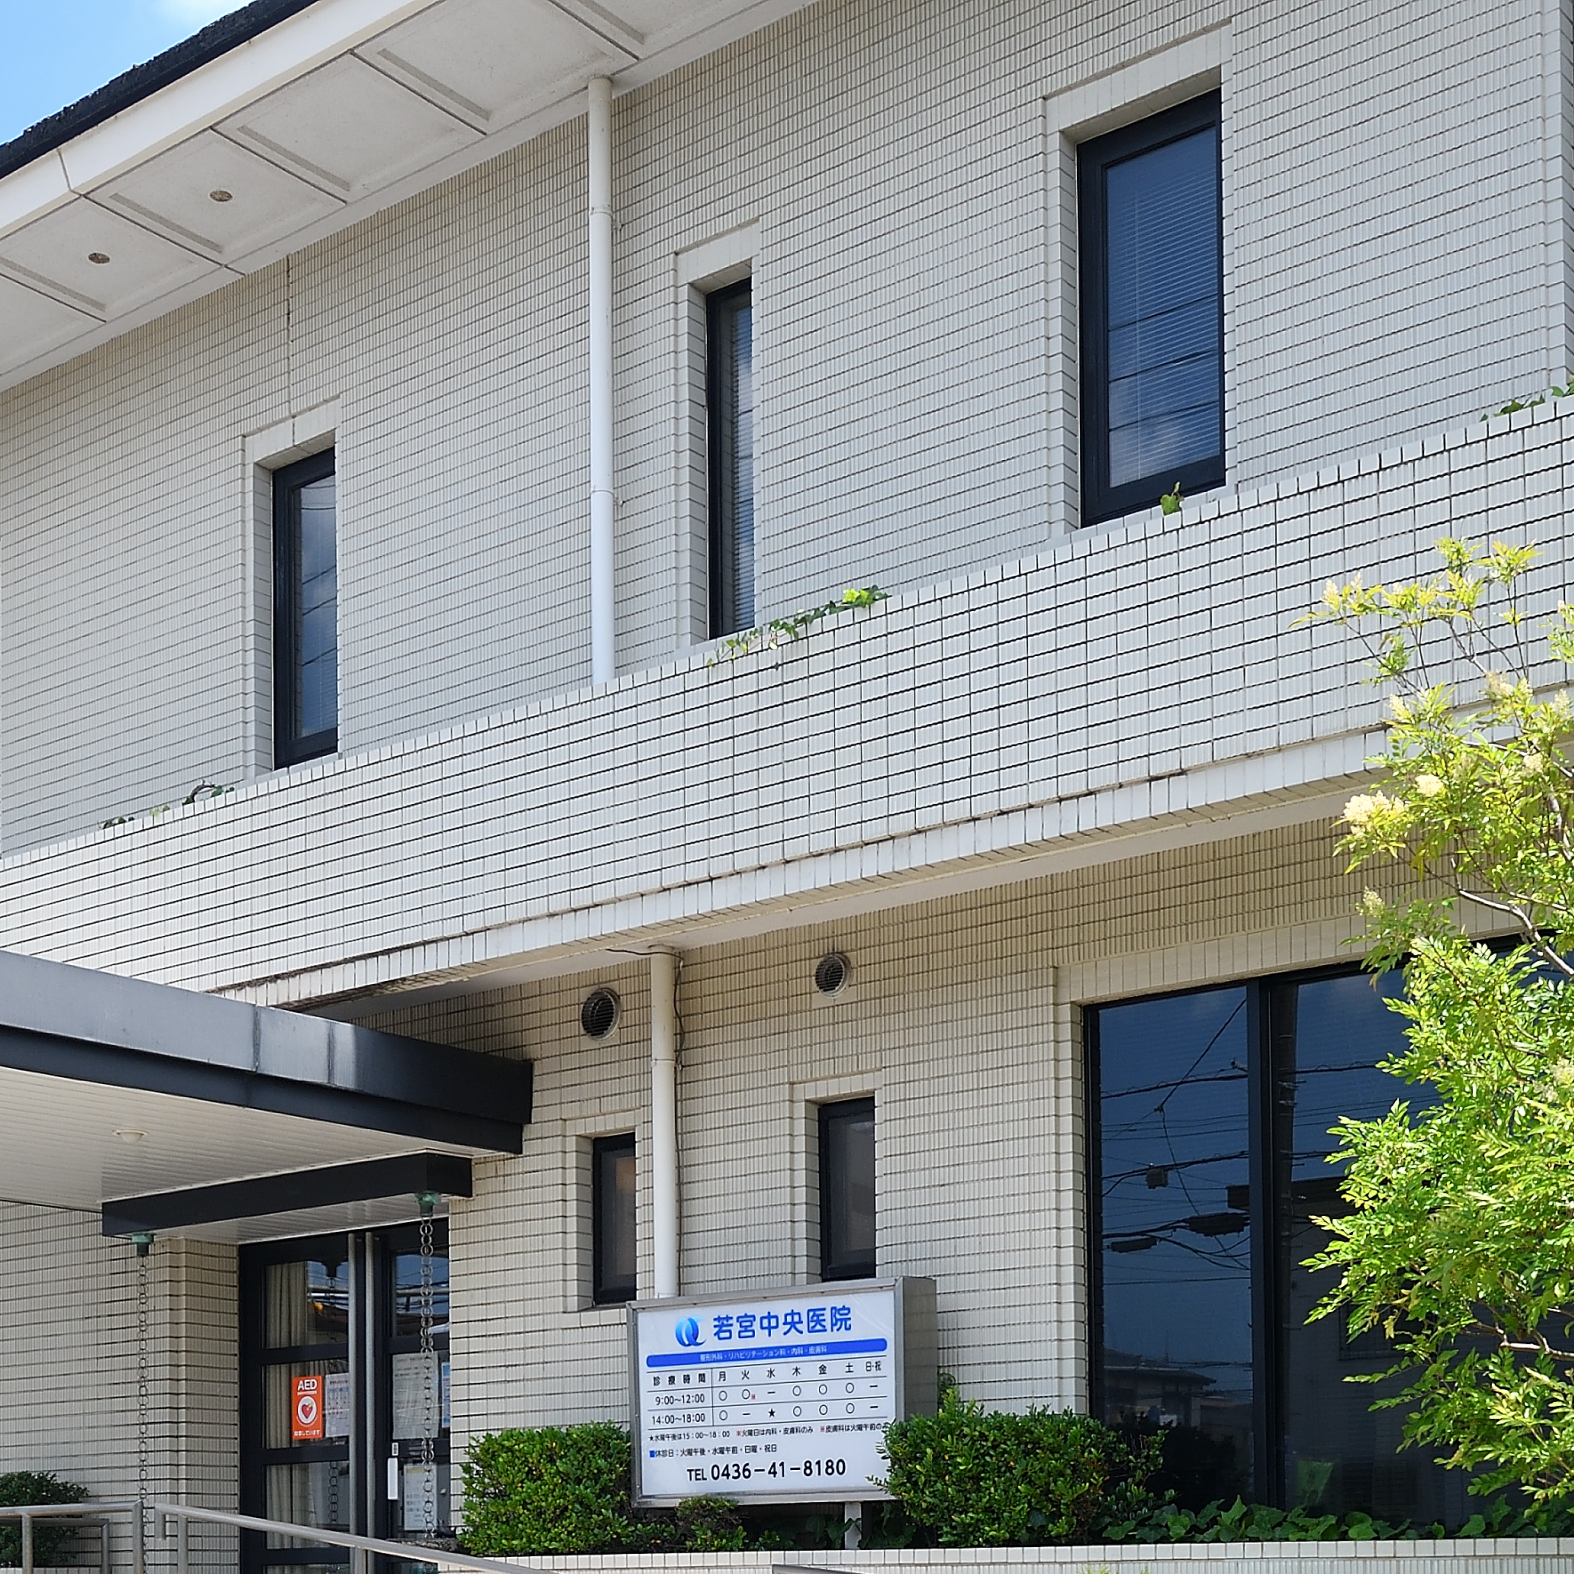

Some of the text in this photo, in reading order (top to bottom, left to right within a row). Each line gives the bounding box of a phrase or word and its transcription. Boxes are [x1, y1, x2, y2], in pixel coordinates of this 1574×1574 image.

[713, 1305, 853, 1341] 若宮中央医院
[718, 1371, 727, 1382] 月
[741, 1369, 750, 1380] 火
[766, 1367, 776, 1379] 水
[792, 1365, 801, 1377] 木
[818, 1363, 827, 1375] 金
[845, 1362, 854, 1373] 土
[297, 1378, 318, 1391] AED
[687, 1468, 707, 1482] TEL
